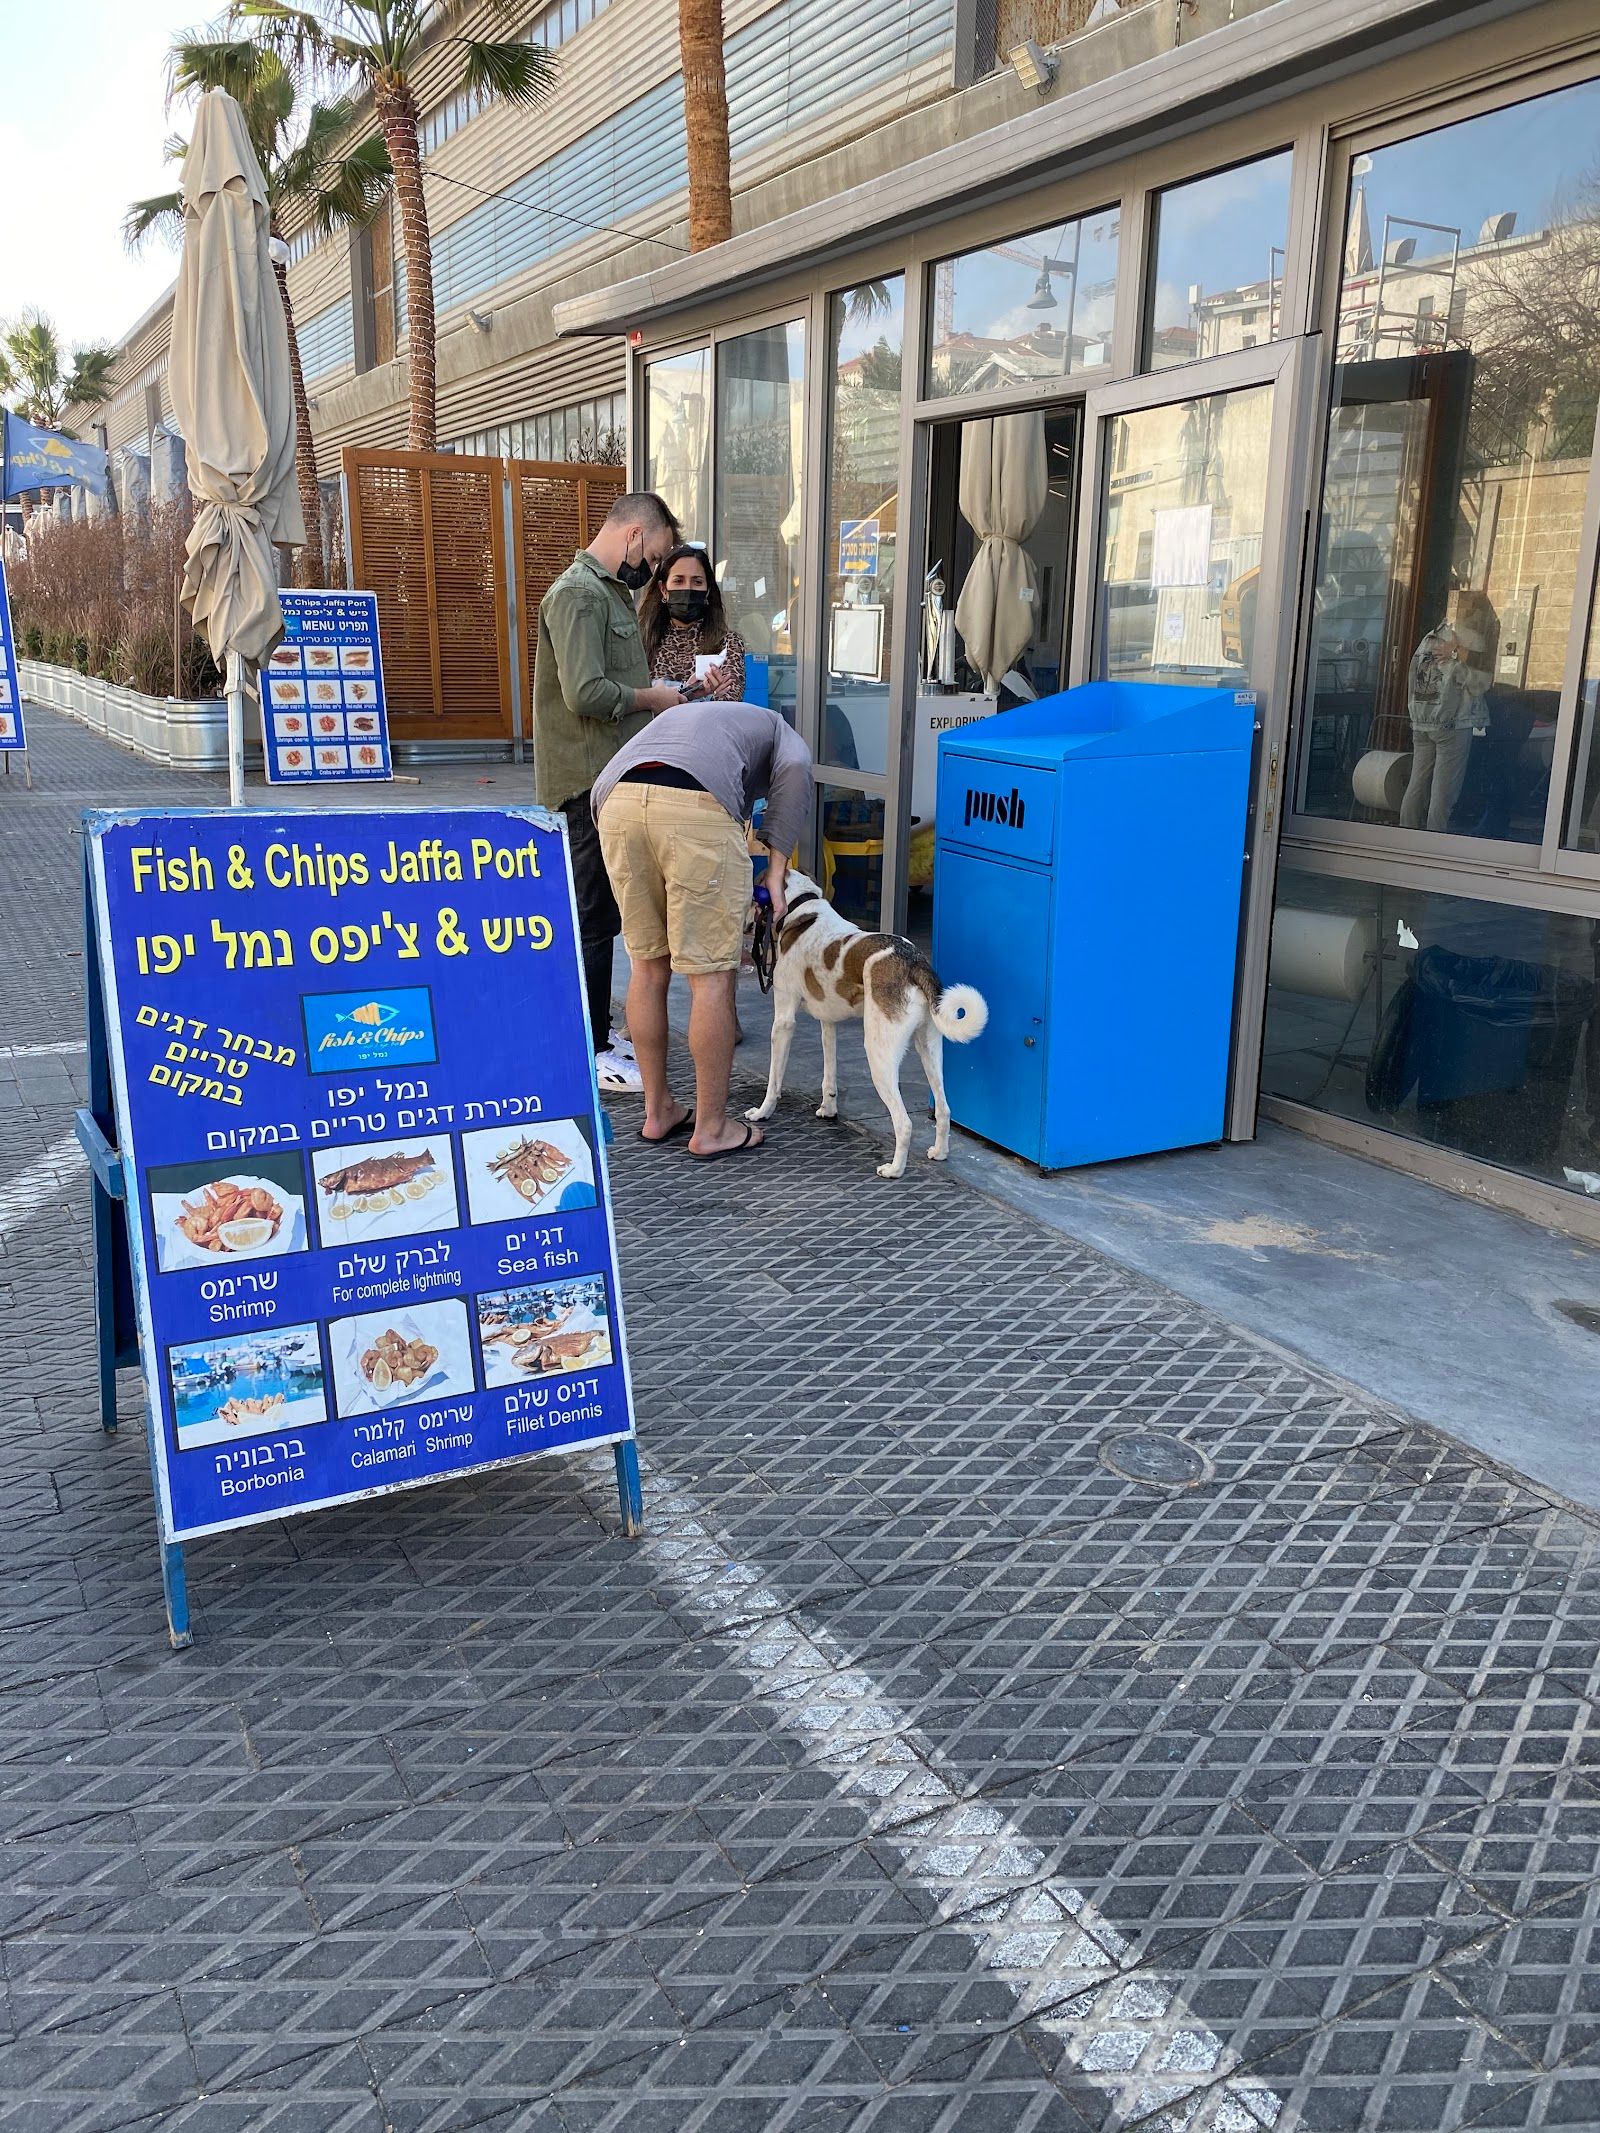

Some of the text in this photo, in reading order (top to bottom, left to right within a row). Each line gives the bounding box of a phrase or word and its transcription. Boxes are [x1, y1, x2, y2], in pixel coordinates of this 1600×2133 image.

[285, 598, 292, 606] &
[295, 599, 321, 607] Chips
[302, 620, 335, 631] MENU
[338, 621, 368, 632] תפריט
[345, 636, 372, 644] מכירת
[930, 716, 986, 729] EXPLORI
[964, 787, 1025, 829] push
[131, 838, 541, 896] Fish & Chips Jaffa Port
[135, 907, 554, 975] פיש & צ'יפס נמל יפו
[135, 1005, 297, 1067] מבחר דגים
[165, 1041, 250, 1079] טריים
[358, 1051, 388, 1060] נמל יפו
[148, 1064, 244, 1107] במקום
[328, 1078, 429, 1108] נמל יפו
[206, 1095, 543, 1153] מכירת דגים טריים במקום
[506, 1225, 565, 1252] דגי ים
[338, 1239, 451, 1279] לברק שלם
[497, 1248, 579, 1276] Sea fish
[200, 1270, 279, 1300] שרימס
[333, 1268, 462, 1303] For complete lightning
[209, 1298, 276, 1323] Shrimp
[504, 1378, 600, 1414] דניס שלם
[353, 1404, 474, 1442] שרימס קלמרי
[506, 1402, 603, 1437] Fillet Dennis
[215, 1438, 306, 1474] ברבוניה
[351, 1430, 473, 1469] Calamari Shrimp
[220, 1465, 305, 1497] Borbonia
